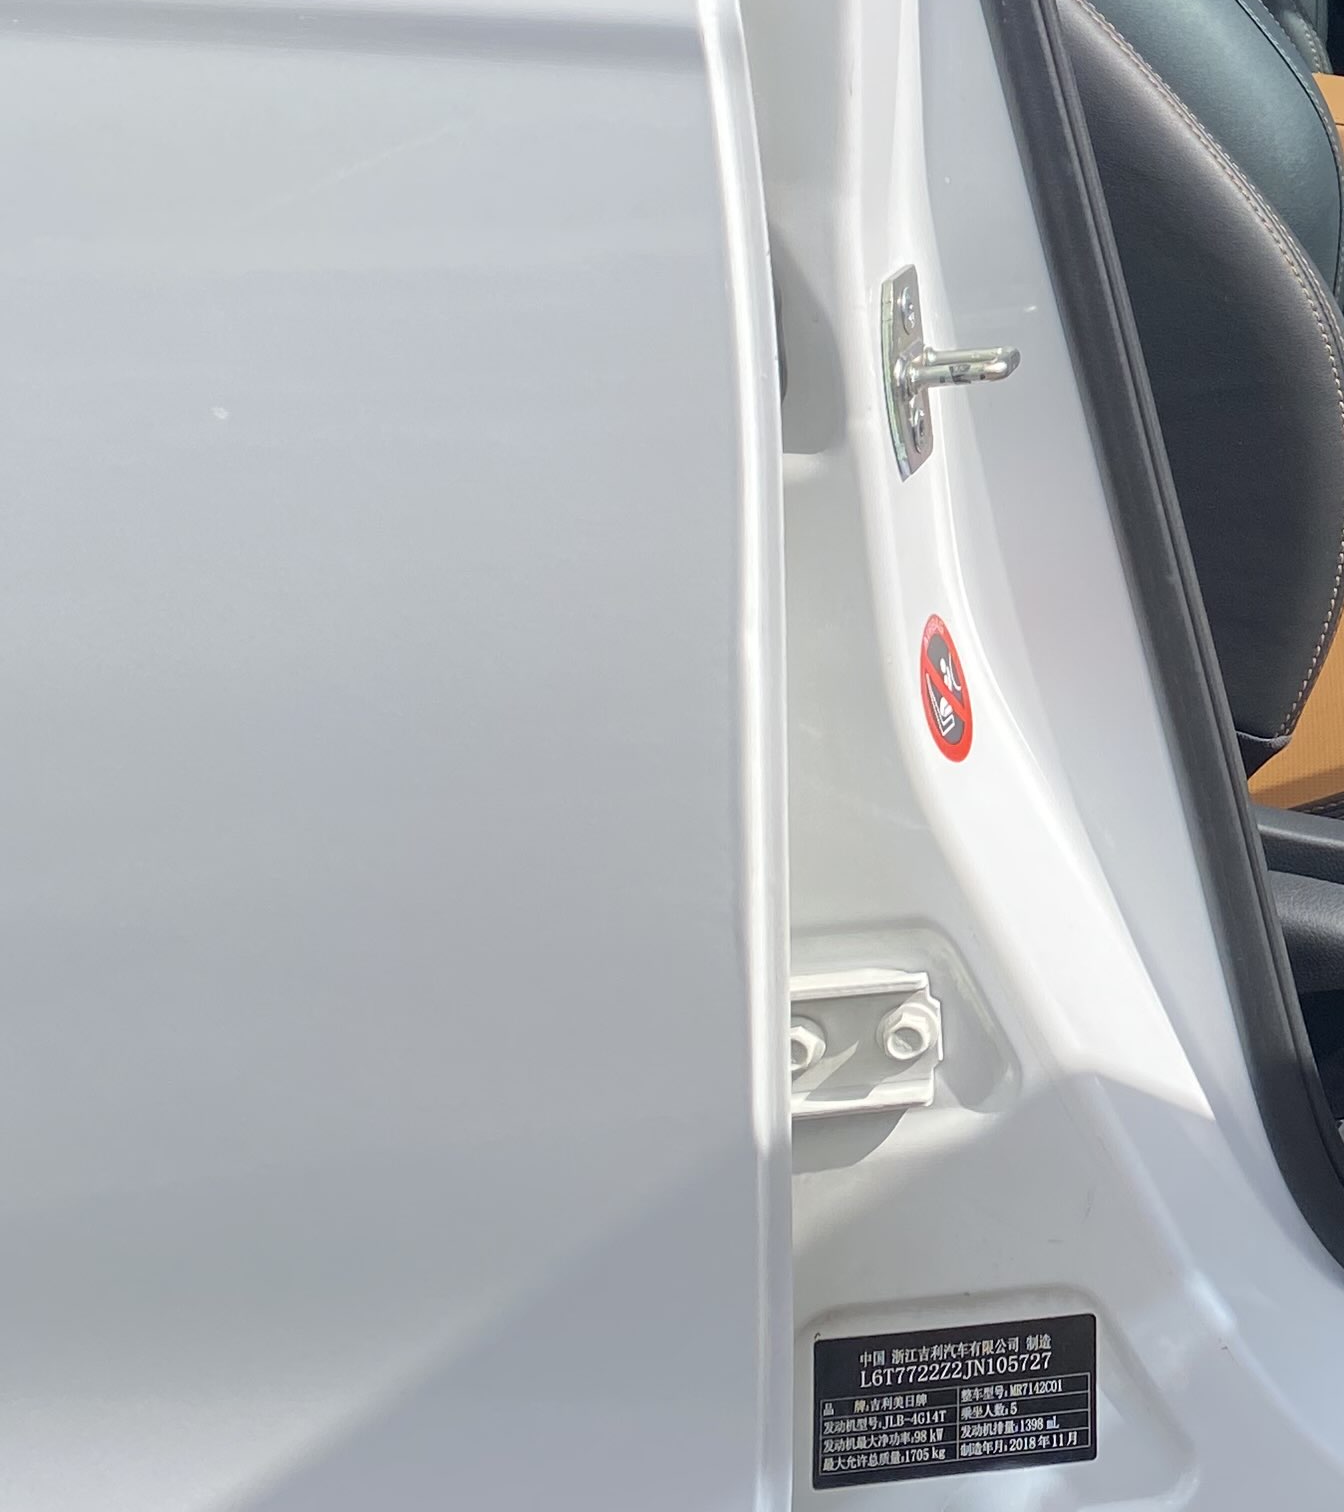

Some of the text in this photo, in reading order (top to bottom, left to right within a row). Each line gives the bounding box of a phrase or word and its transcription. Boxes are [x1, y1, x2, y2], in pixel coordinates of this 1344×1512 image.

[859, 1333, 1051, 1368] 中国 浙江吉利汽车有限公司 制造
[860, 1352, 1052, 1388] L6T7722Z2JN105727
